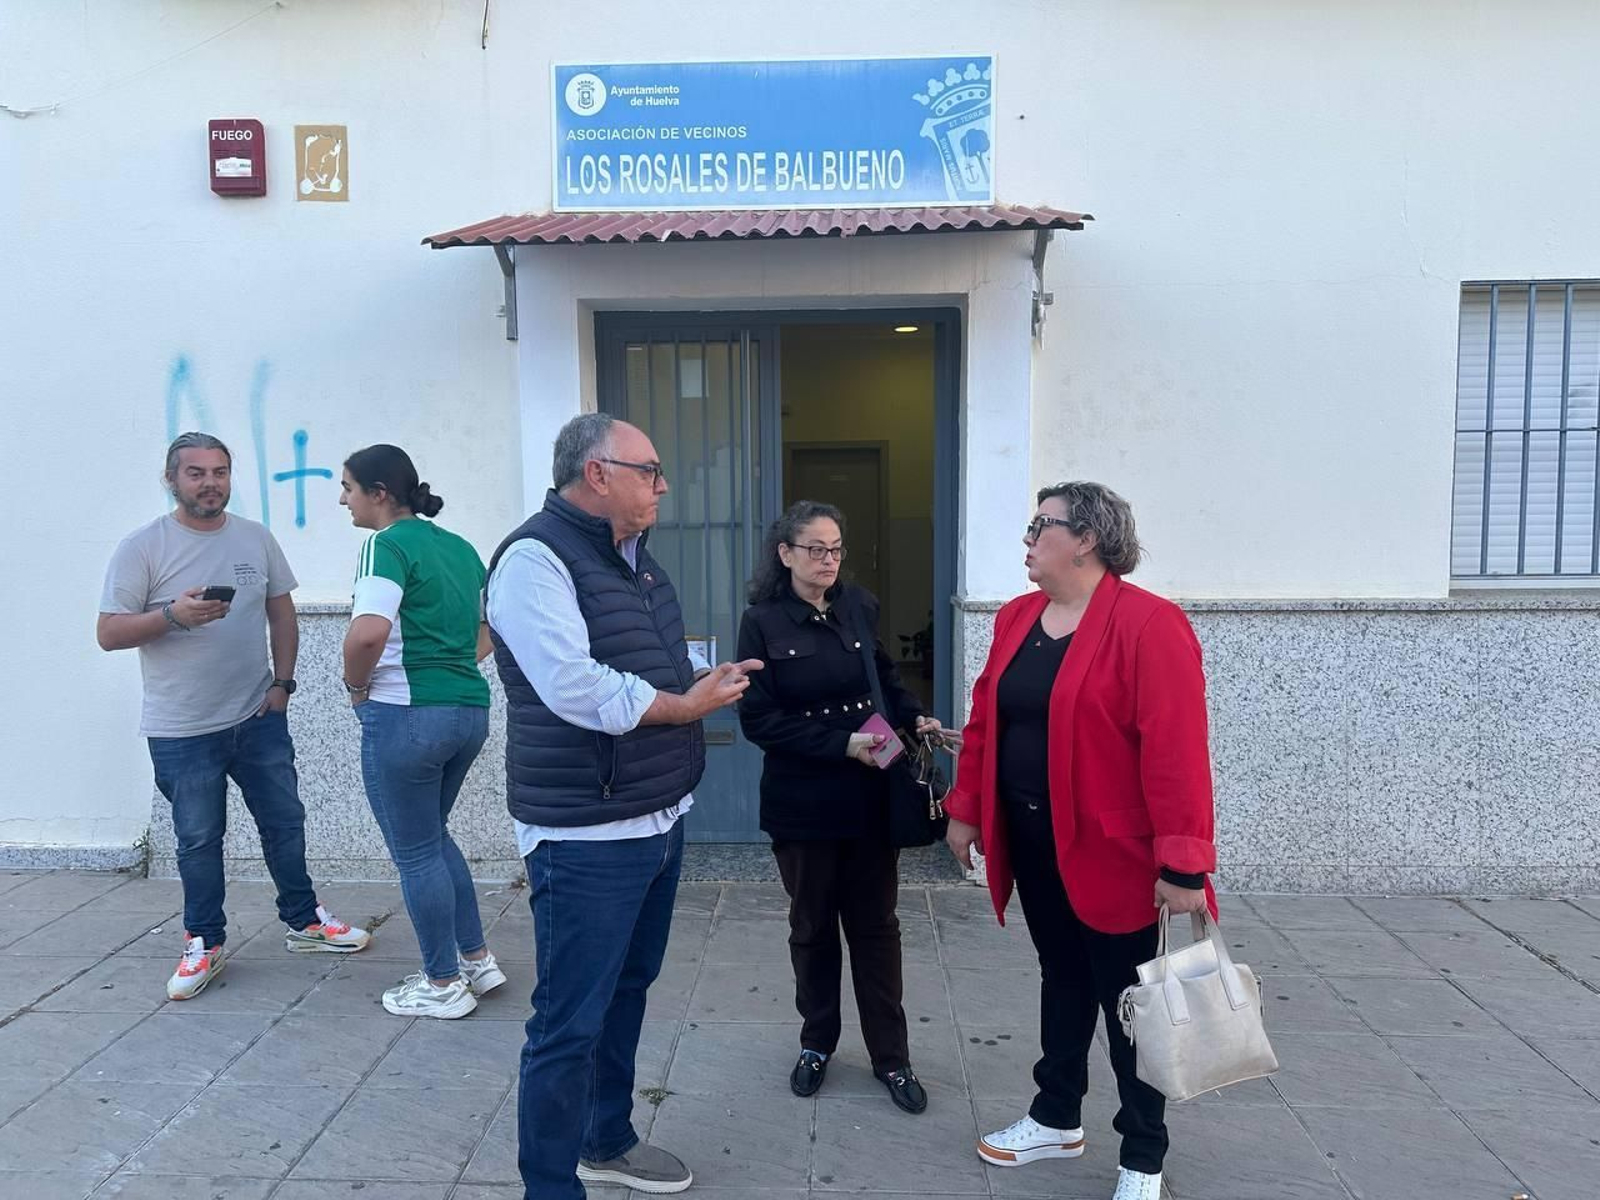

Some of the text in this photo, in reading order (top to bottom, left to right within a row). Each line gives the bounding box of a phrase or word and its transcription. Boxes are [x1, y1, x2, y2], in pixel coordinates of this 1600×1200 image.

[610, 85, 680, 97] Ayuntamiento
[630, 96, 680, 106] de Huelva
[211, 130, 253, 141] FUEGO
[566, 125, 747, 141] ASOCIACIÓN DE VECINOS
[566, 149, 905, 195] LOS ROSALES DE BALBUENO
